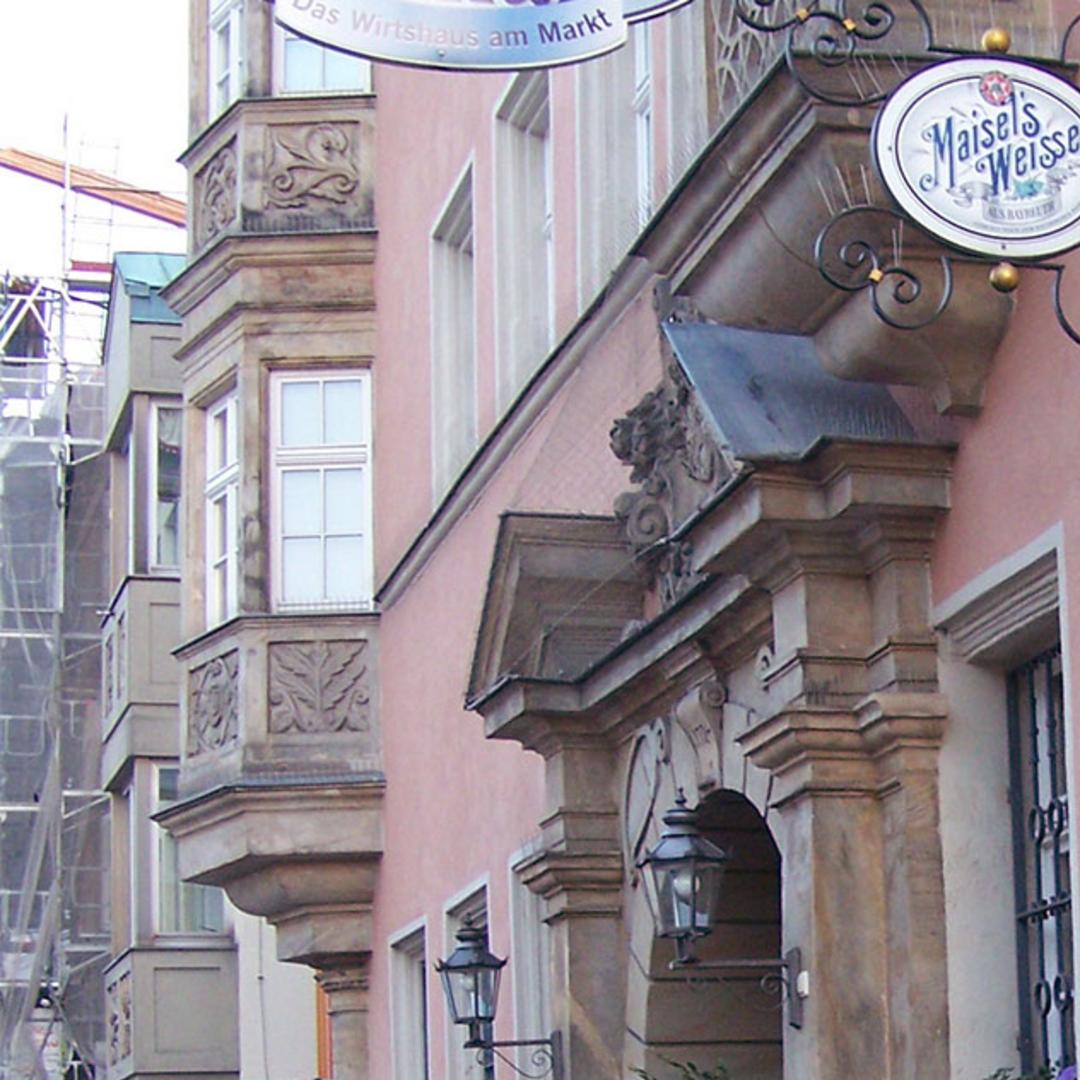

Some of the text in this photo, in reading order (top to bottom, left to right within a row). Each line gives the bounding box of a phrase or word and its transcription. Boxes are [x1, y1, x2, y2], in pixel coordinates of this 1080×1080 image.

[293, 0, 613, 47] Das Wirtshaus am Markt
